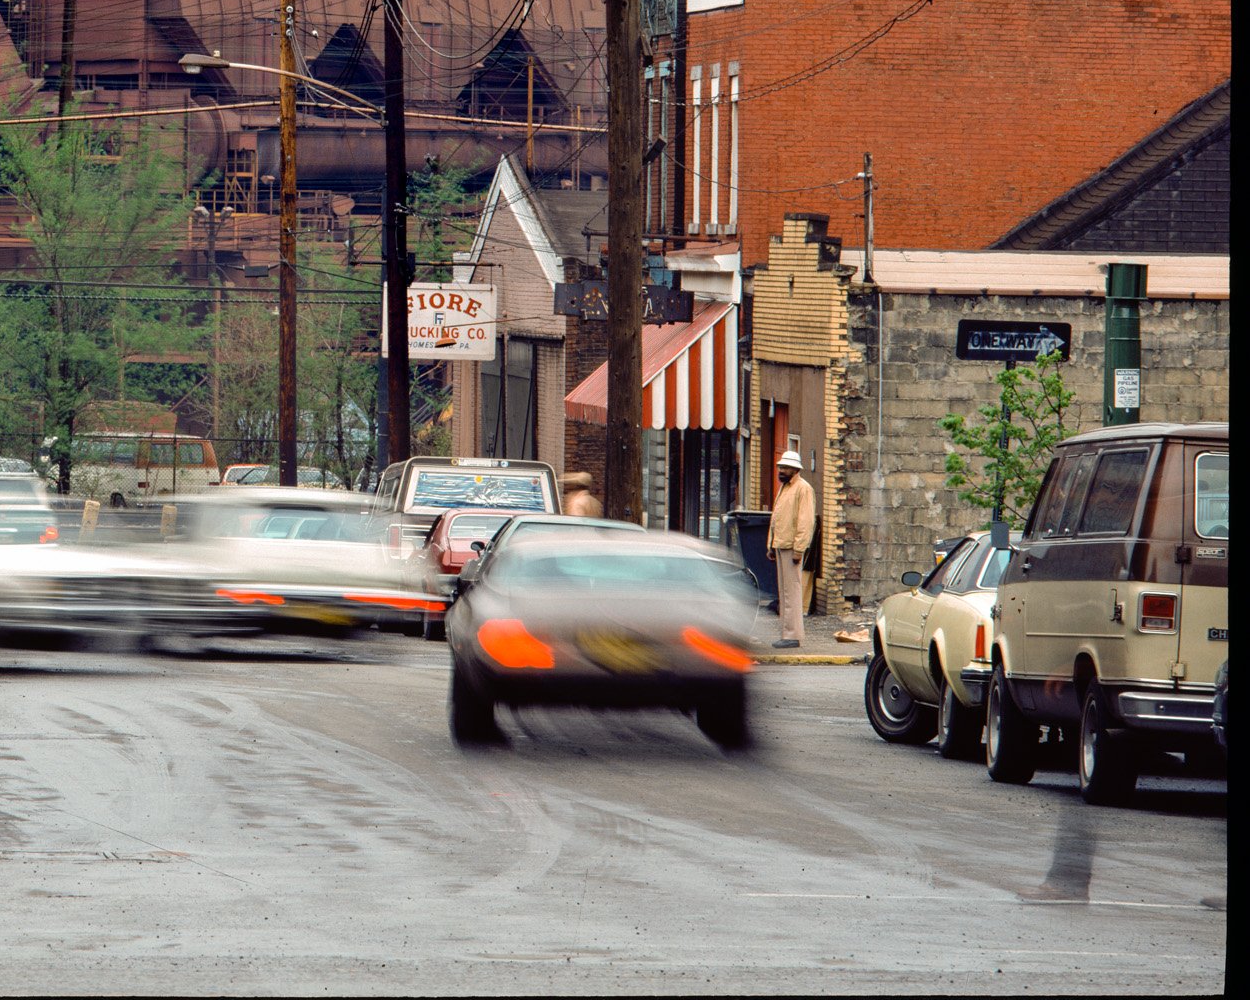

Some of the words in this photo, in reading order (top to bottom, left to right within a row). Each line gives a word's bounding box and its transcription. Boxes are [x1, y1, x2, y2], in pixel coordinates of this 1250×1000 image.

[467, 328, 487, 339] CO.
[971, 332, 1000, 348] ONE
[1002, 333, 1037, 349] WAY
